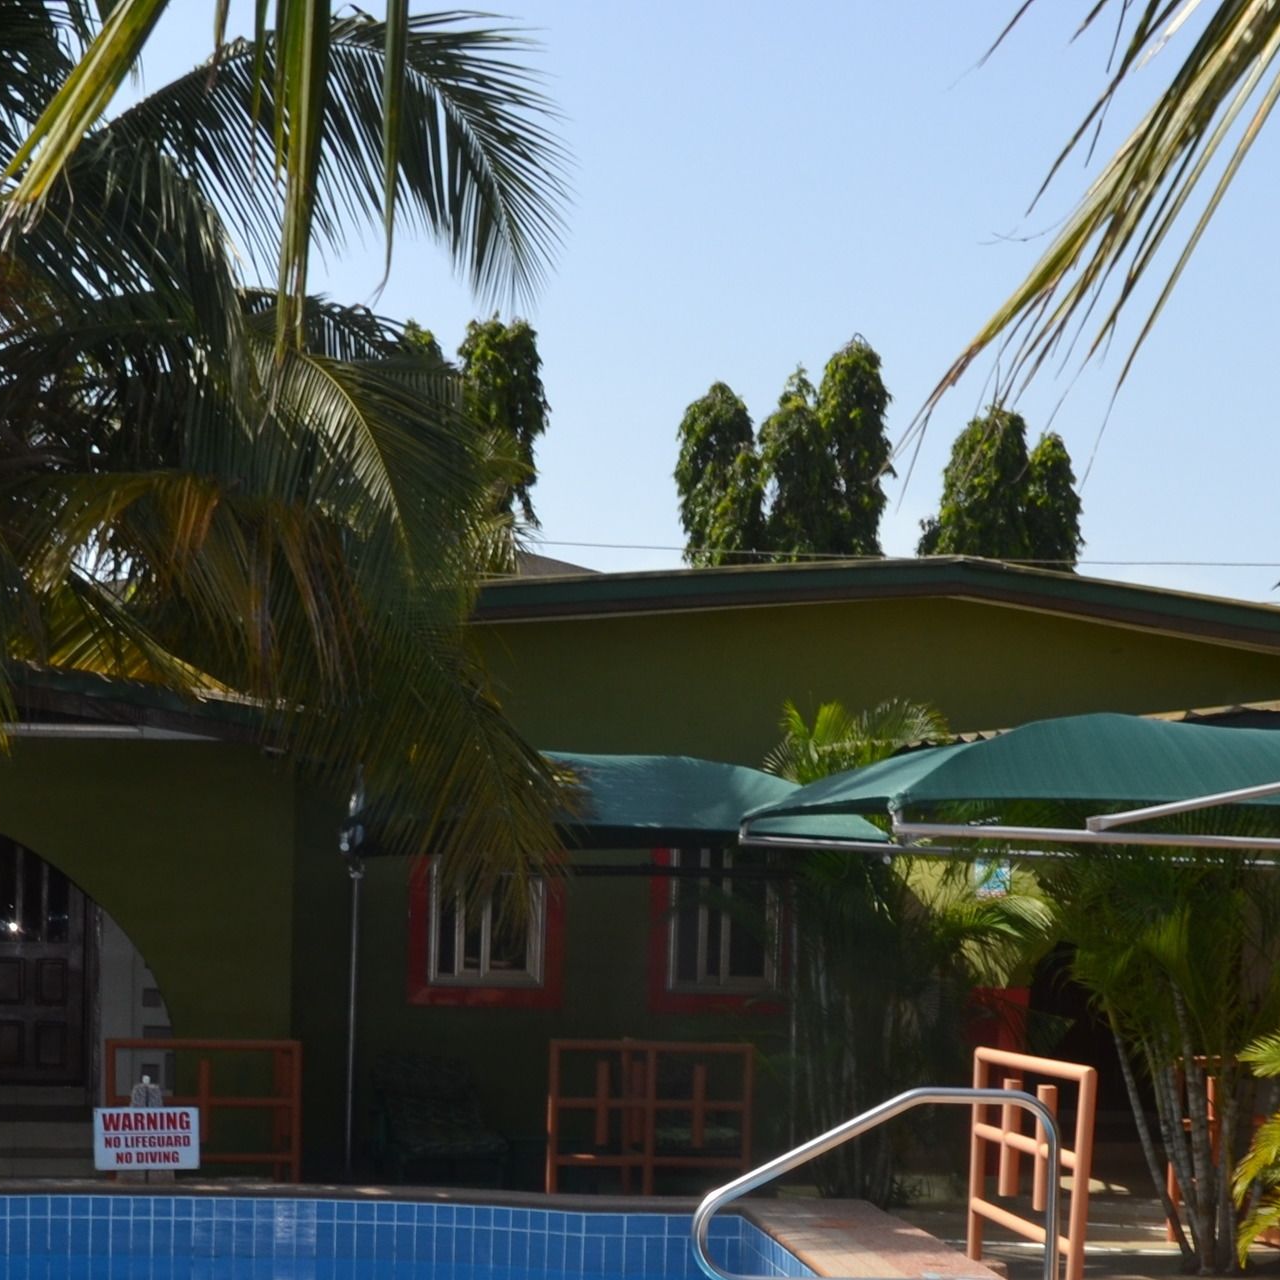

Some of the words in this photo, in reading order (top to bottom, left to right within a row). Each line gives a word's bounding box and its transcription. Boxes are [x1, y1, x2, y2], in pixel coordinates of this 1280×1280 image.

[102, 1111, 191, 1131] WARNING
[104, 1135, 121, 1149] NO
[124, 1135, 191, 1148] LIFEGUARD
[115, 1151, 133, 1164] NO
[136, 1151, 180, 1163] DIVING
